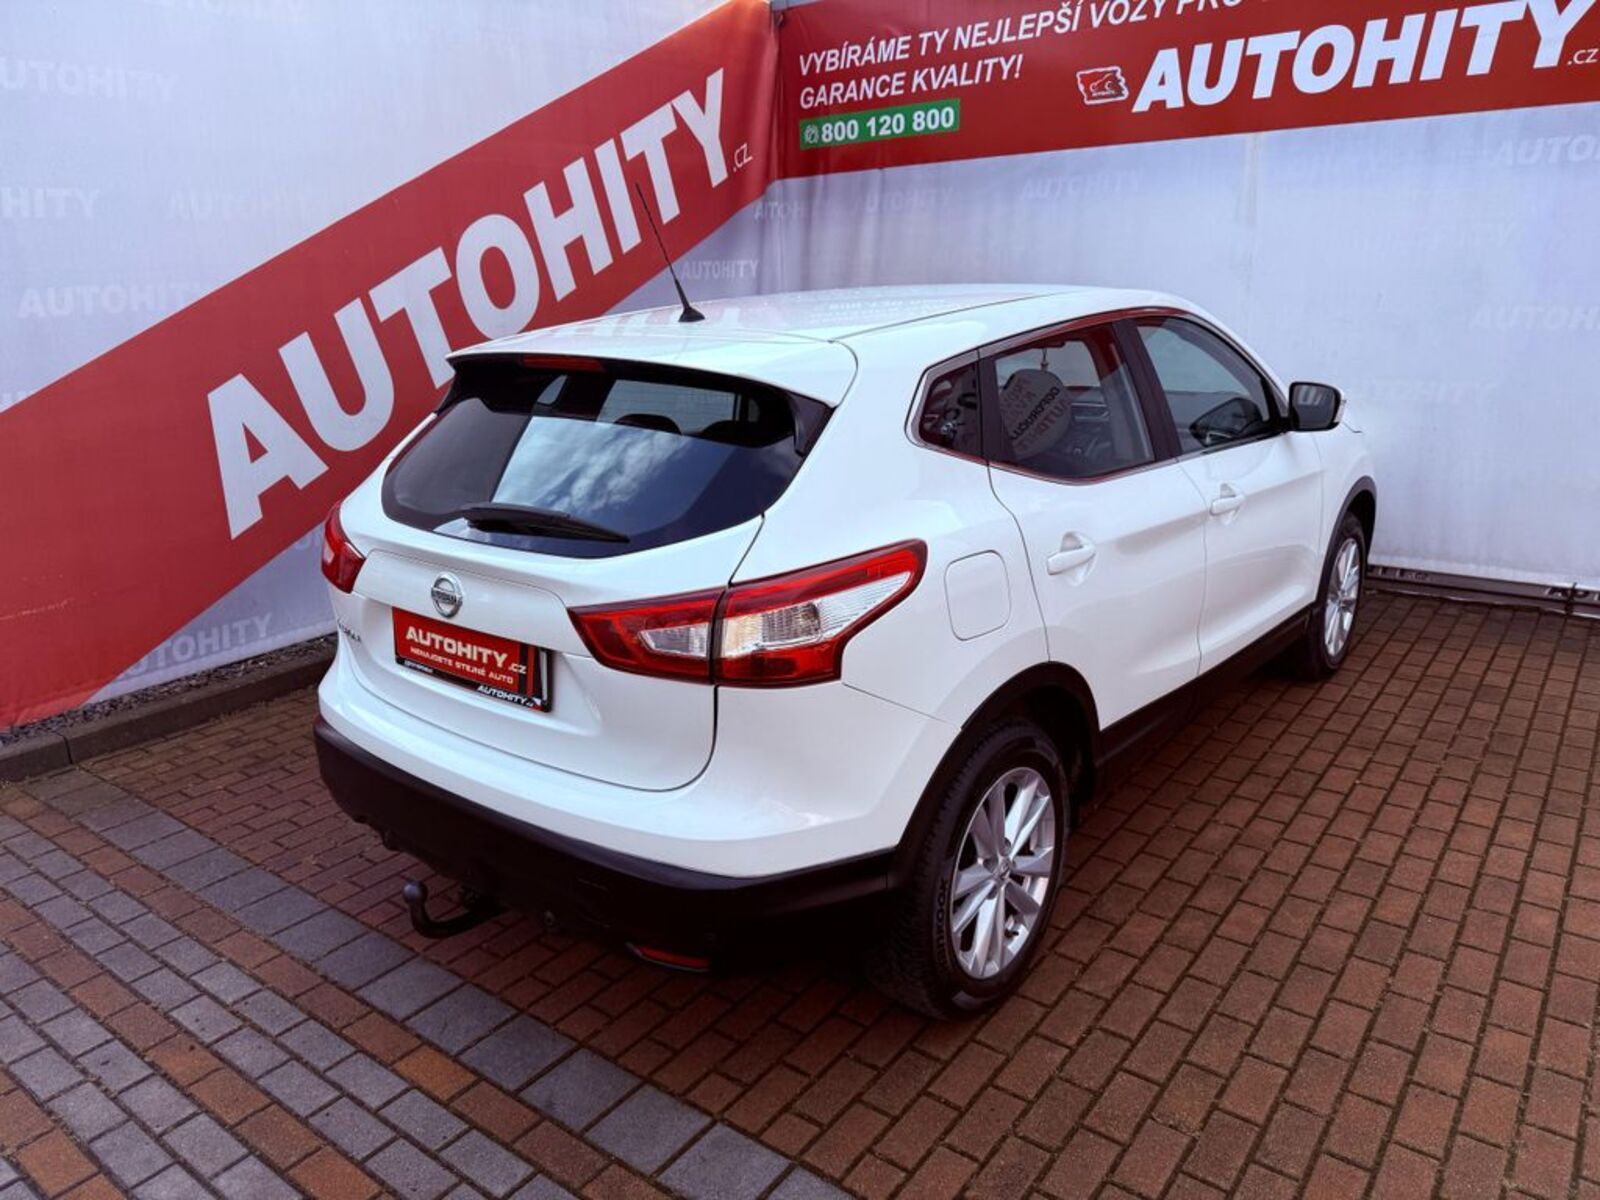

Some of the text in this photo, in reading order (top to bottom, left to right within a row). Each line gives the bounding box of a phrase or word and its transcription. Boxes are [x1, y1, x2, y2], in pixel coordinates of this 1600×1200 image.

[800, 36, 912, 76] VYBÍRÁME
[919, 28, 950, 56] TY
[954, 2, 1082, 50] NEJLEPŠÍ
[1090, 0, 1166, 28] VOZY
[1131, 0, 1597, 113] AUTOHITY
[800, 53, 1024, 110] GARANCE KVALITY!
[821, 106, 956, 143] 800 120 800
[1495, 133, 1600, 166] AUTO
[206, 67, 724, 539] AUTOHITY
[405, 626, 508, 669] AUTOHITY
[488, 671, 514, 685] AUTO
